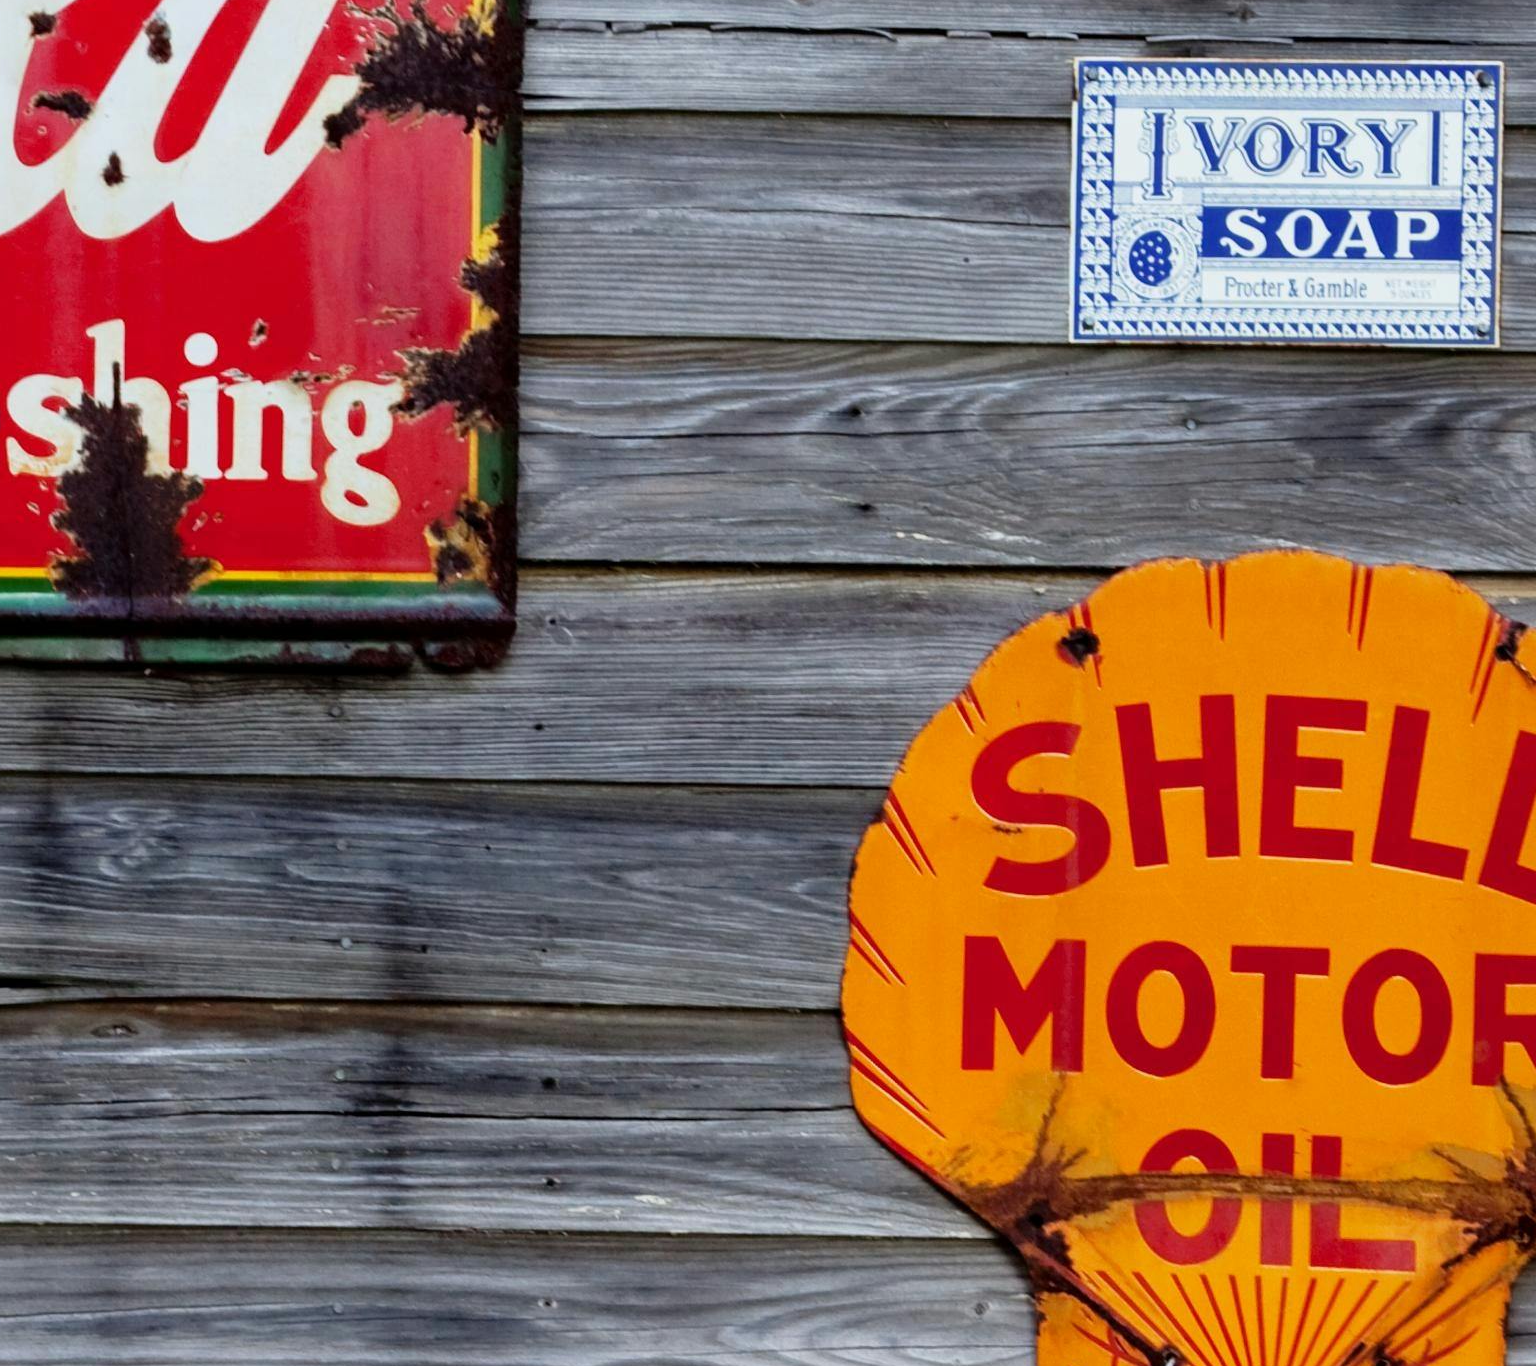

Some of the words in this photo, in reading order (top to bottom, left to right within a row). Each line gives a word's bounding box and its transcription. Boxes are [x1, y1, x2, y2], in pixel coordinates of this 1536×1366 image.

[1139, 107, 1417, 201] IVORY
[1219, 208, 1441, 260] SOAP
[1224, 276, 1281, 299] Procter
[1287, 278, 1299, 298] &
[1303, 277, 1368, 300] Gamble
[1134, 1128, 1417, 1273] OIL
